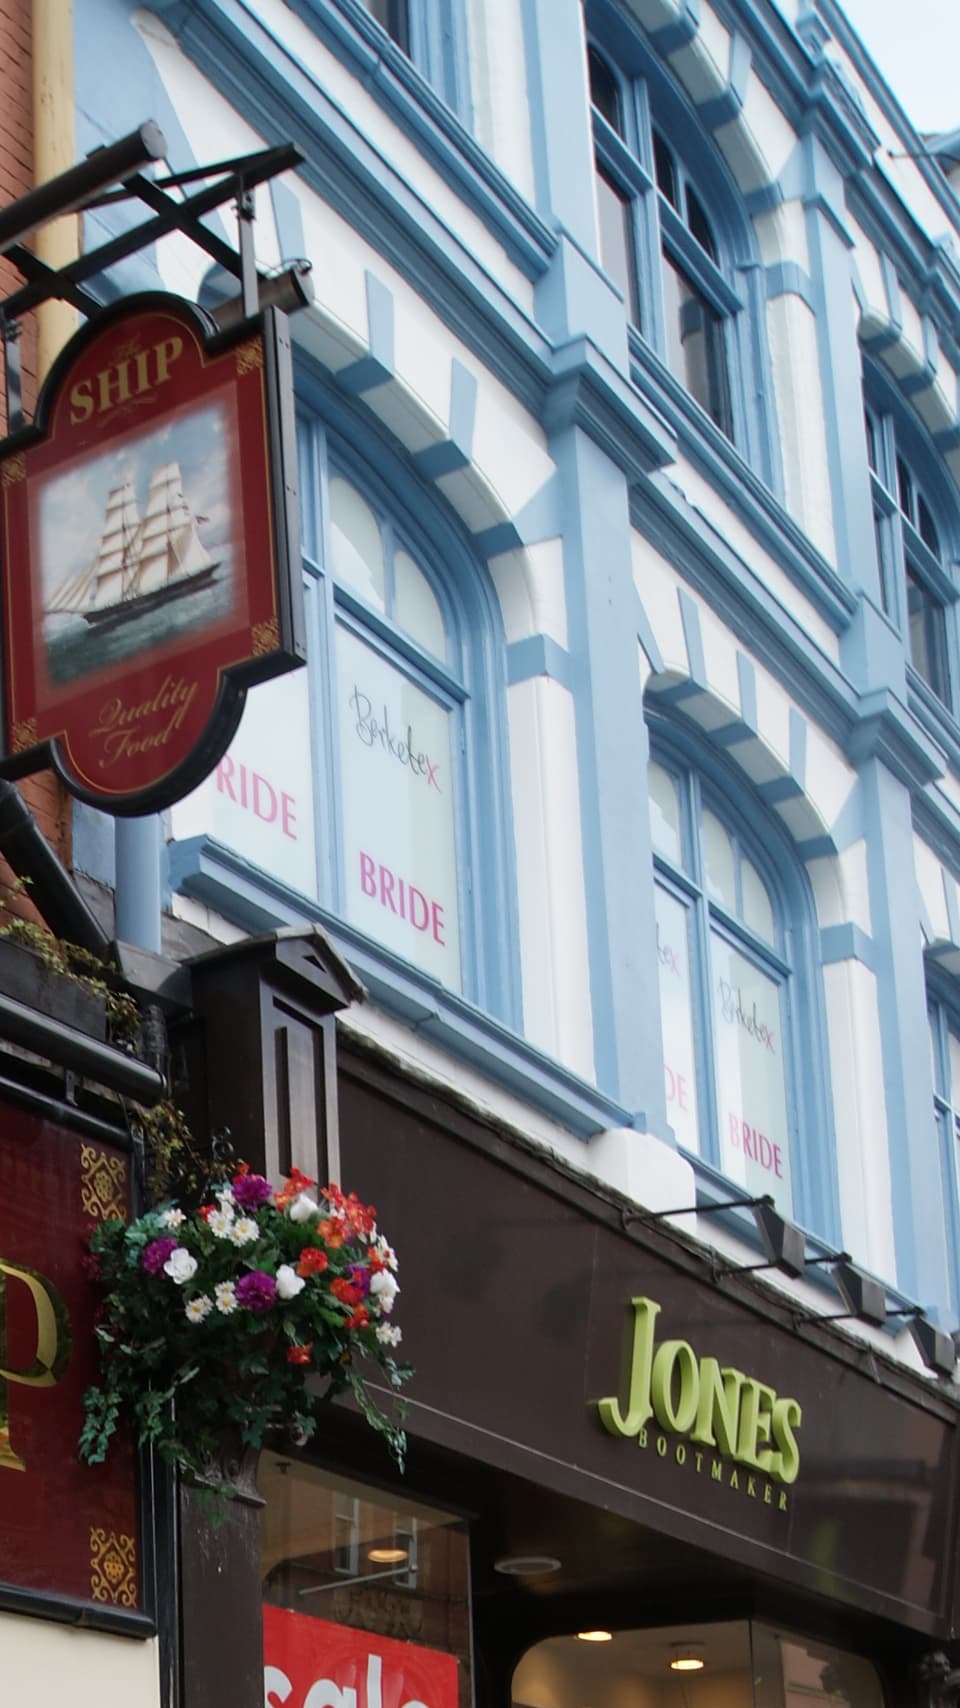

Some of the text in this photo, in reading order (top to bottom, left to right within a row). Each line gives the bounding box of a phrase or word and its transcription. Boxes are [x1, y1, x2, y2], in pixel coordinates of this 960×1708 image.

[70, 336, 183, 425] SHIP
[88, 674, 198, 737] Quality
[99, 706, 182, 768] Food
[348, 684, 442, 794] Berketex
[214, 752, 297, 841] RIDE
[359, 850, 445, 947] BRIDE
[728, 1111, 783, 1181] BRIDE
[598, 1296, 802, 1484] JONES
[639, 1427, 788, 1511] BOOTMAKER
